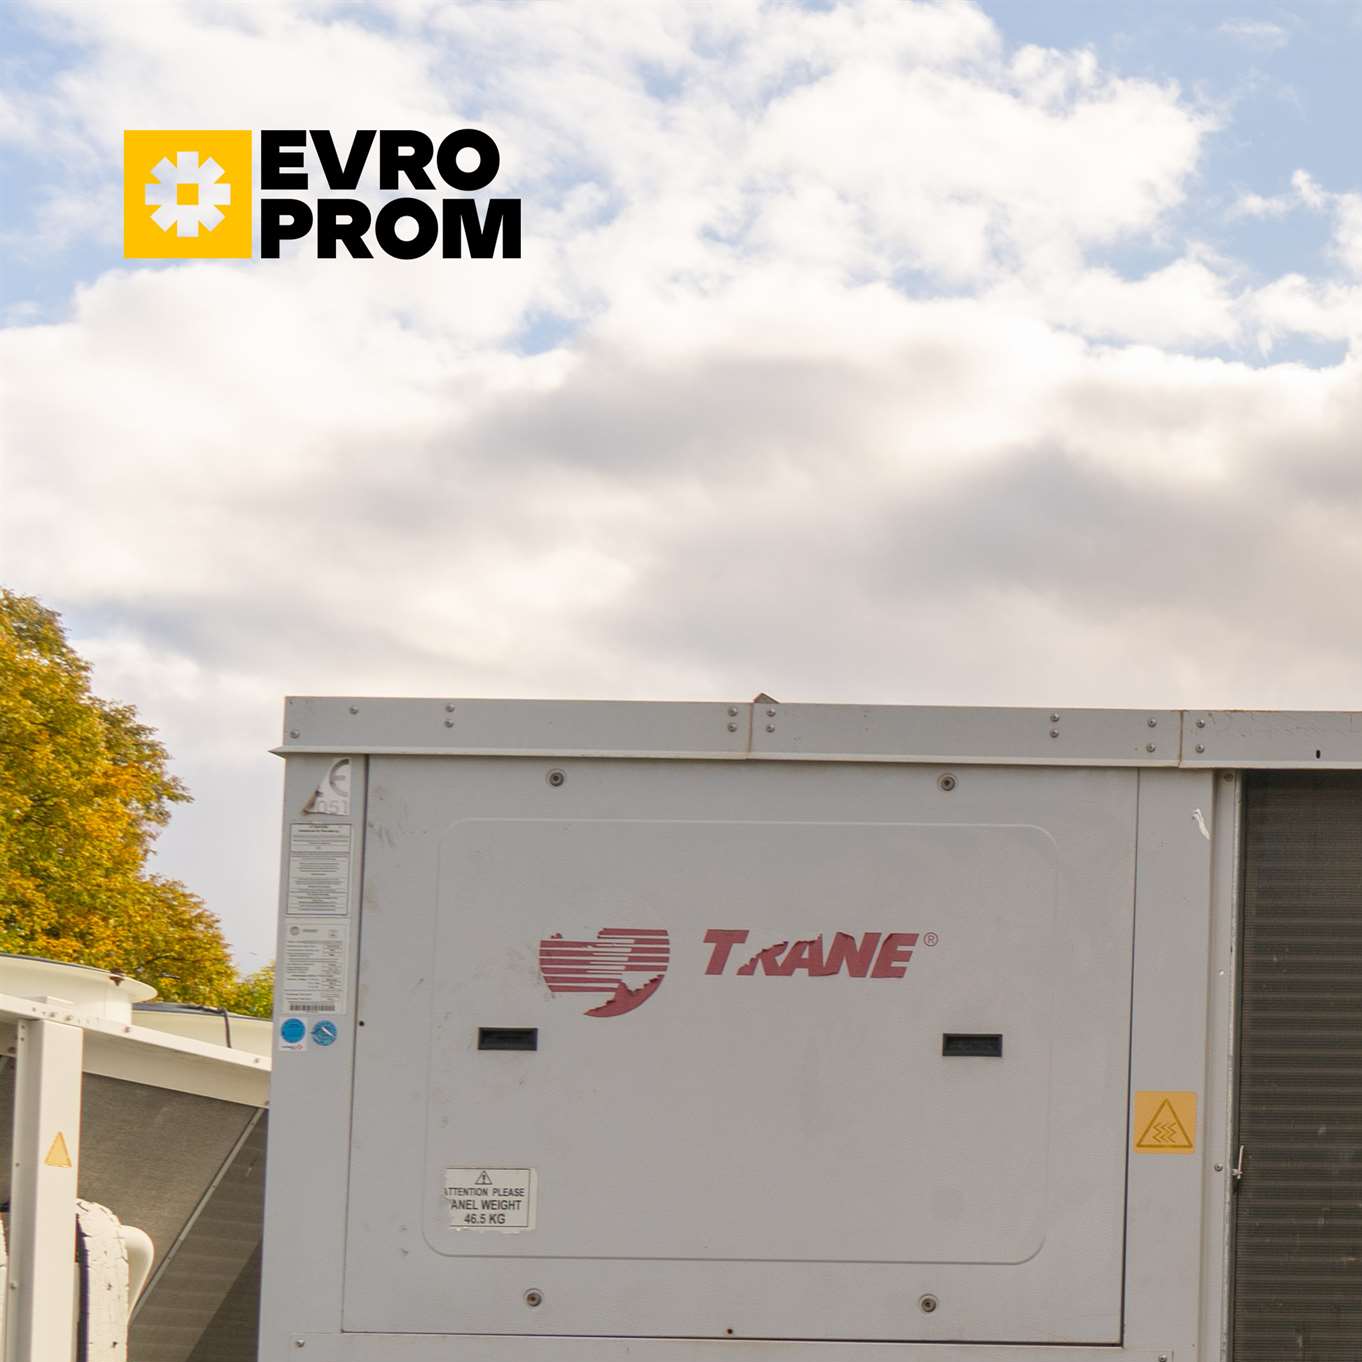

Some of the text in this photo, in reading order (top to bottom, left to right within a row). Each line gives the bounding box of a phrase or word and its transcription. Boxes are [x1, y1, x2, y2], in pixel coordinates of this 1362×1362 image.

[492, 1187, 526, 1197] PLEASE
[449, 1199, 522, 1211] ANEL WEIGHT
[463, 1213, 506, 1225] 46.5 KG
